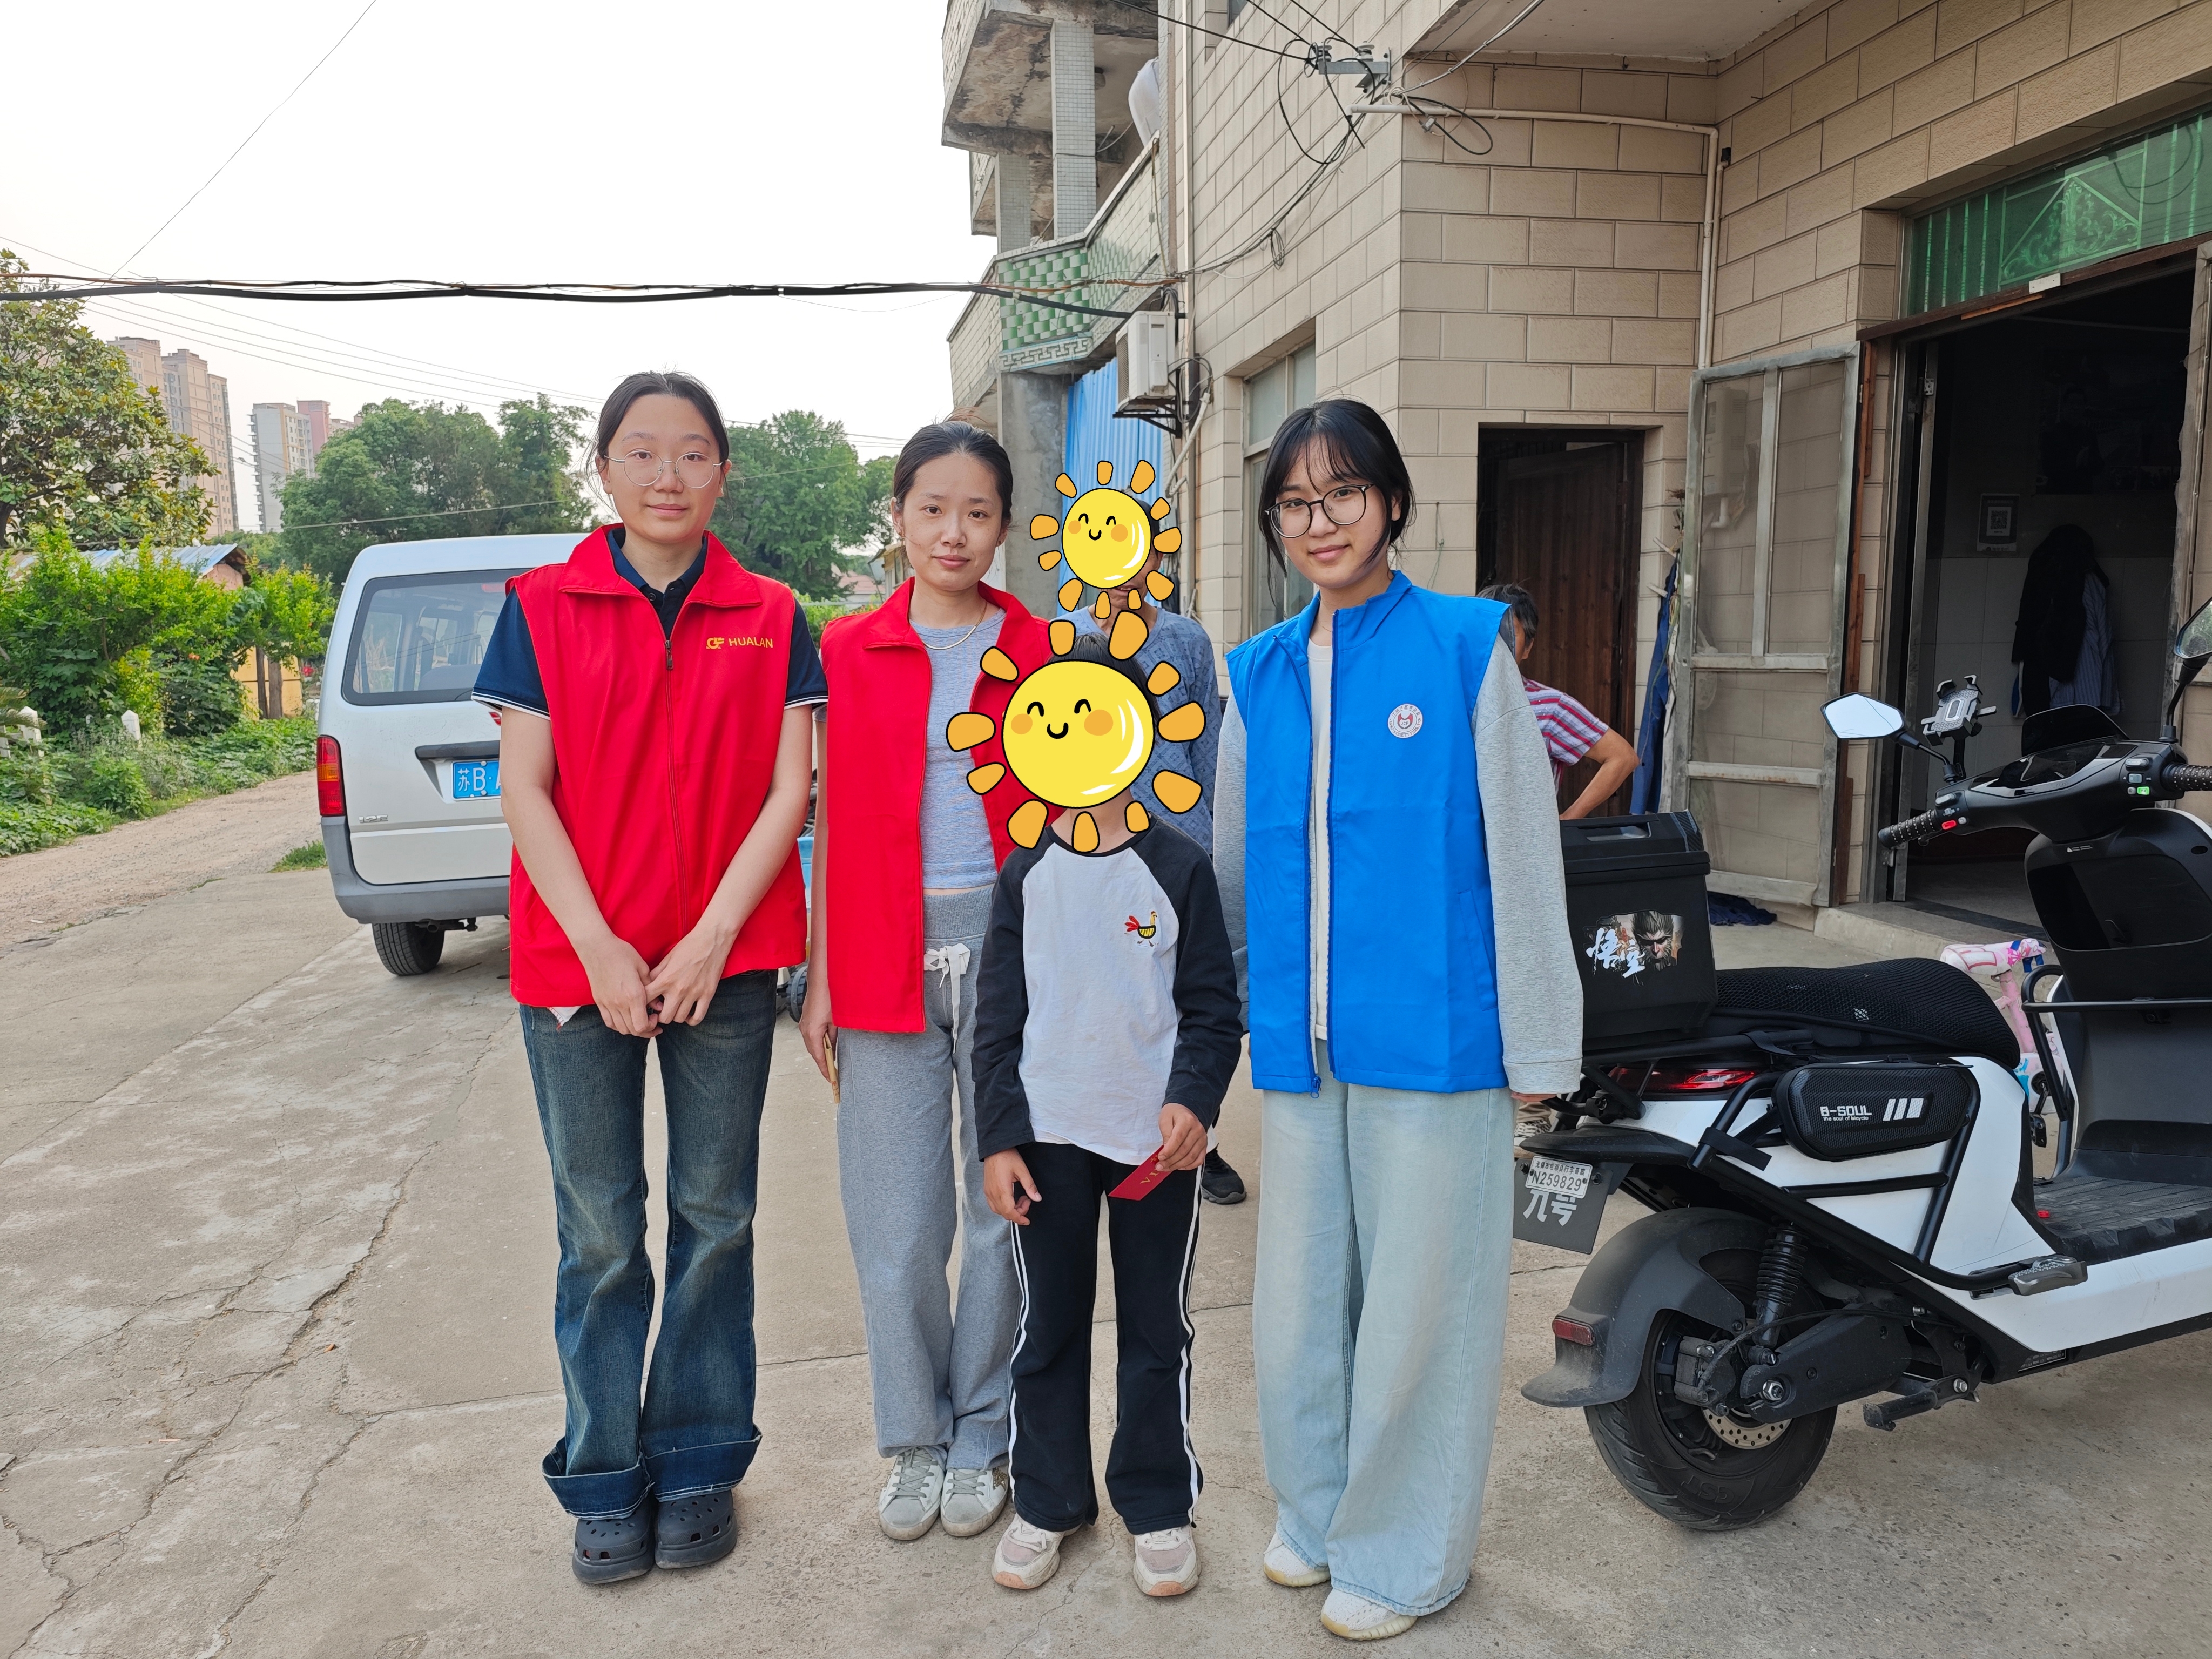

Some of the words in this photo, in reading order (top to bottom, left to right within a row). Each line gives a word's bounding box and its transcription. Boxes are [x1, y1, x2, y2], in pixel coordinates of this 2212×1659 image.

[729, 637, 773, 648] HUALAN
[1820, 1105, 1872, 1116] B-SOUL
[1139, 1168, 1159, 1184] VI
[1532, 1171, 1582, 1191] N259829
